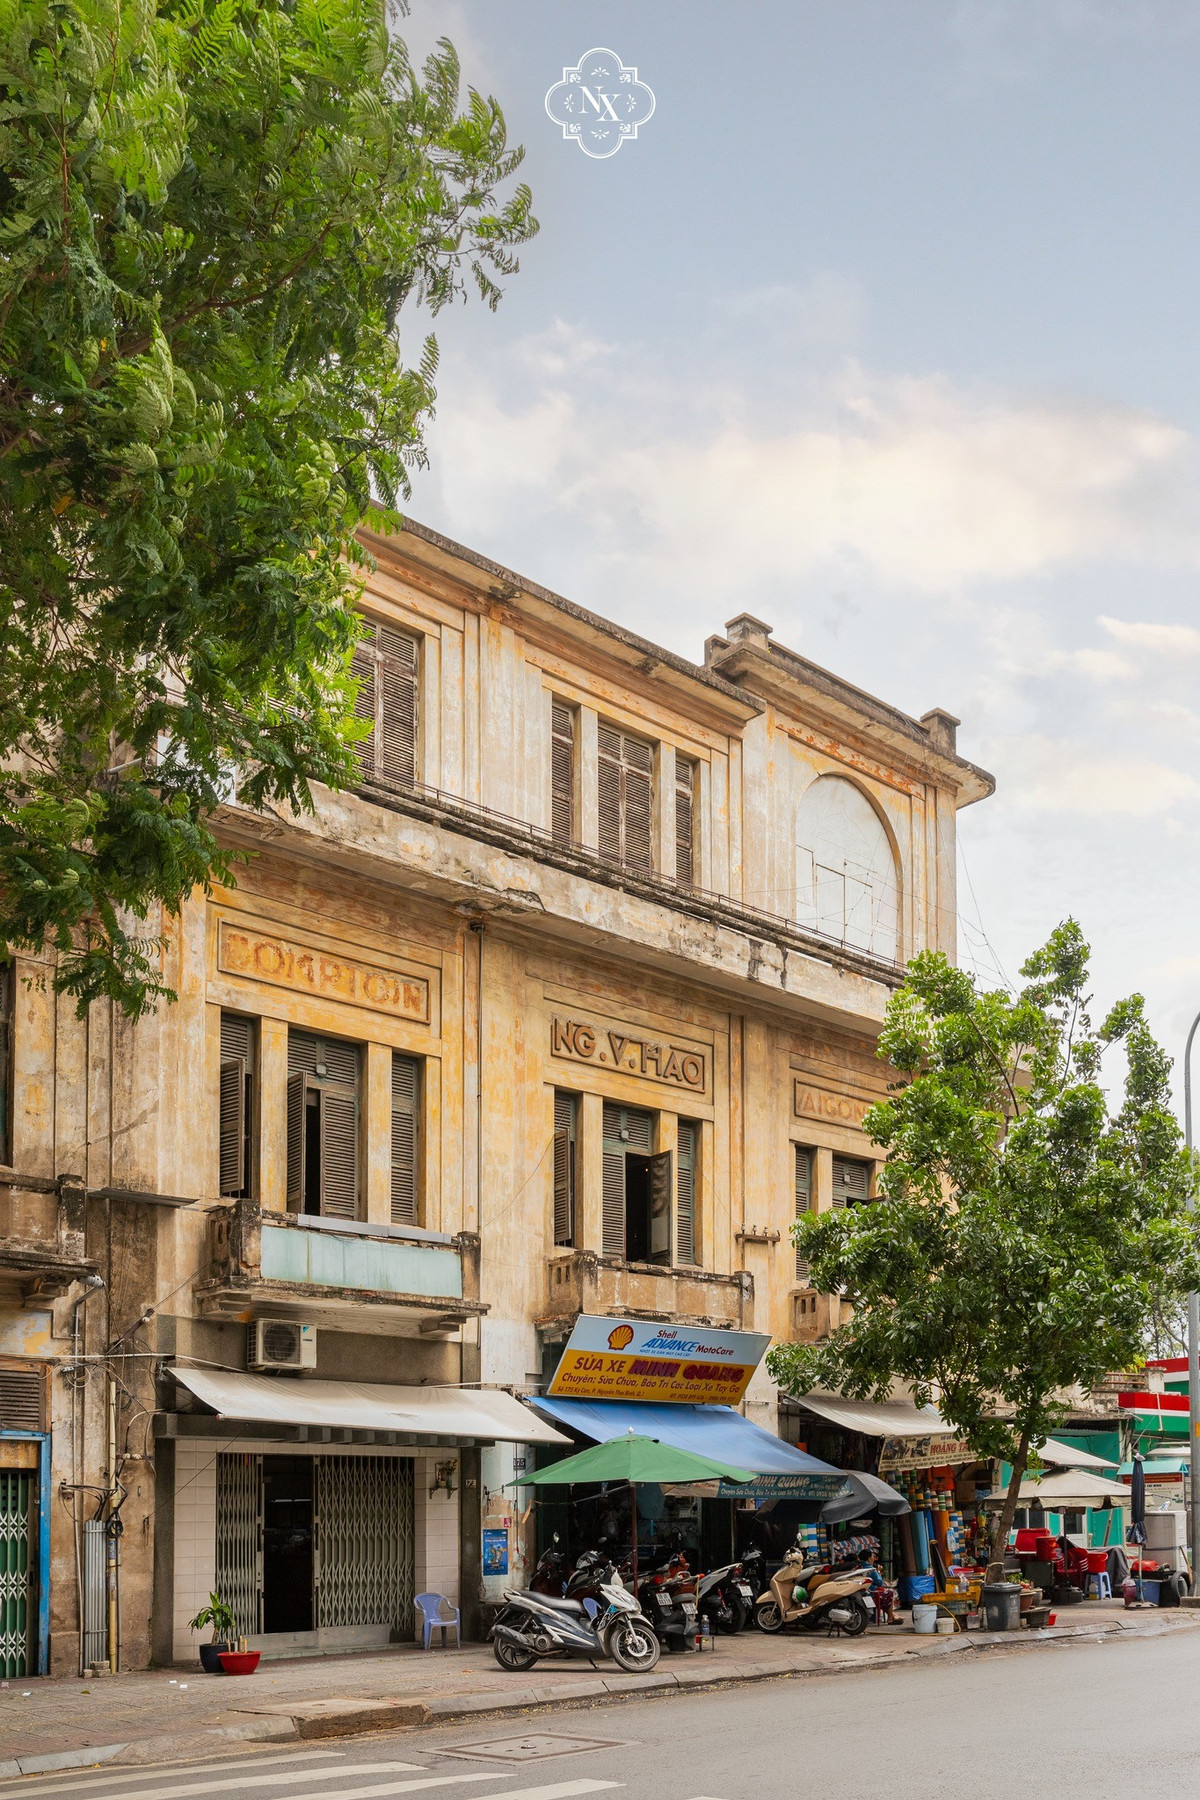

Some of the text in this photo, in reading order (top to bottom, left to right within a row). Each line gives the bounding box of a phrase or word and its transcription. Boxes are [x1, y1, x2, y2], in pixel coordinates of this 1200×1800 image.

[656, 1330, 678, 1339] Shell
[641, 1338, 734, 1356] ADVANCE MotoCare
[606, 1359, 627, 1373] XE
[628, 1358, 681, 1378] MINH
[683, 1364, 745, 1383] QUANG
[702, 1383, 713, 1392] Xe
[716, 1384, 728, 1394] Tay
[729, 1384, 740, 1393] Ga
[465, 1479, 477, 1487] 173
